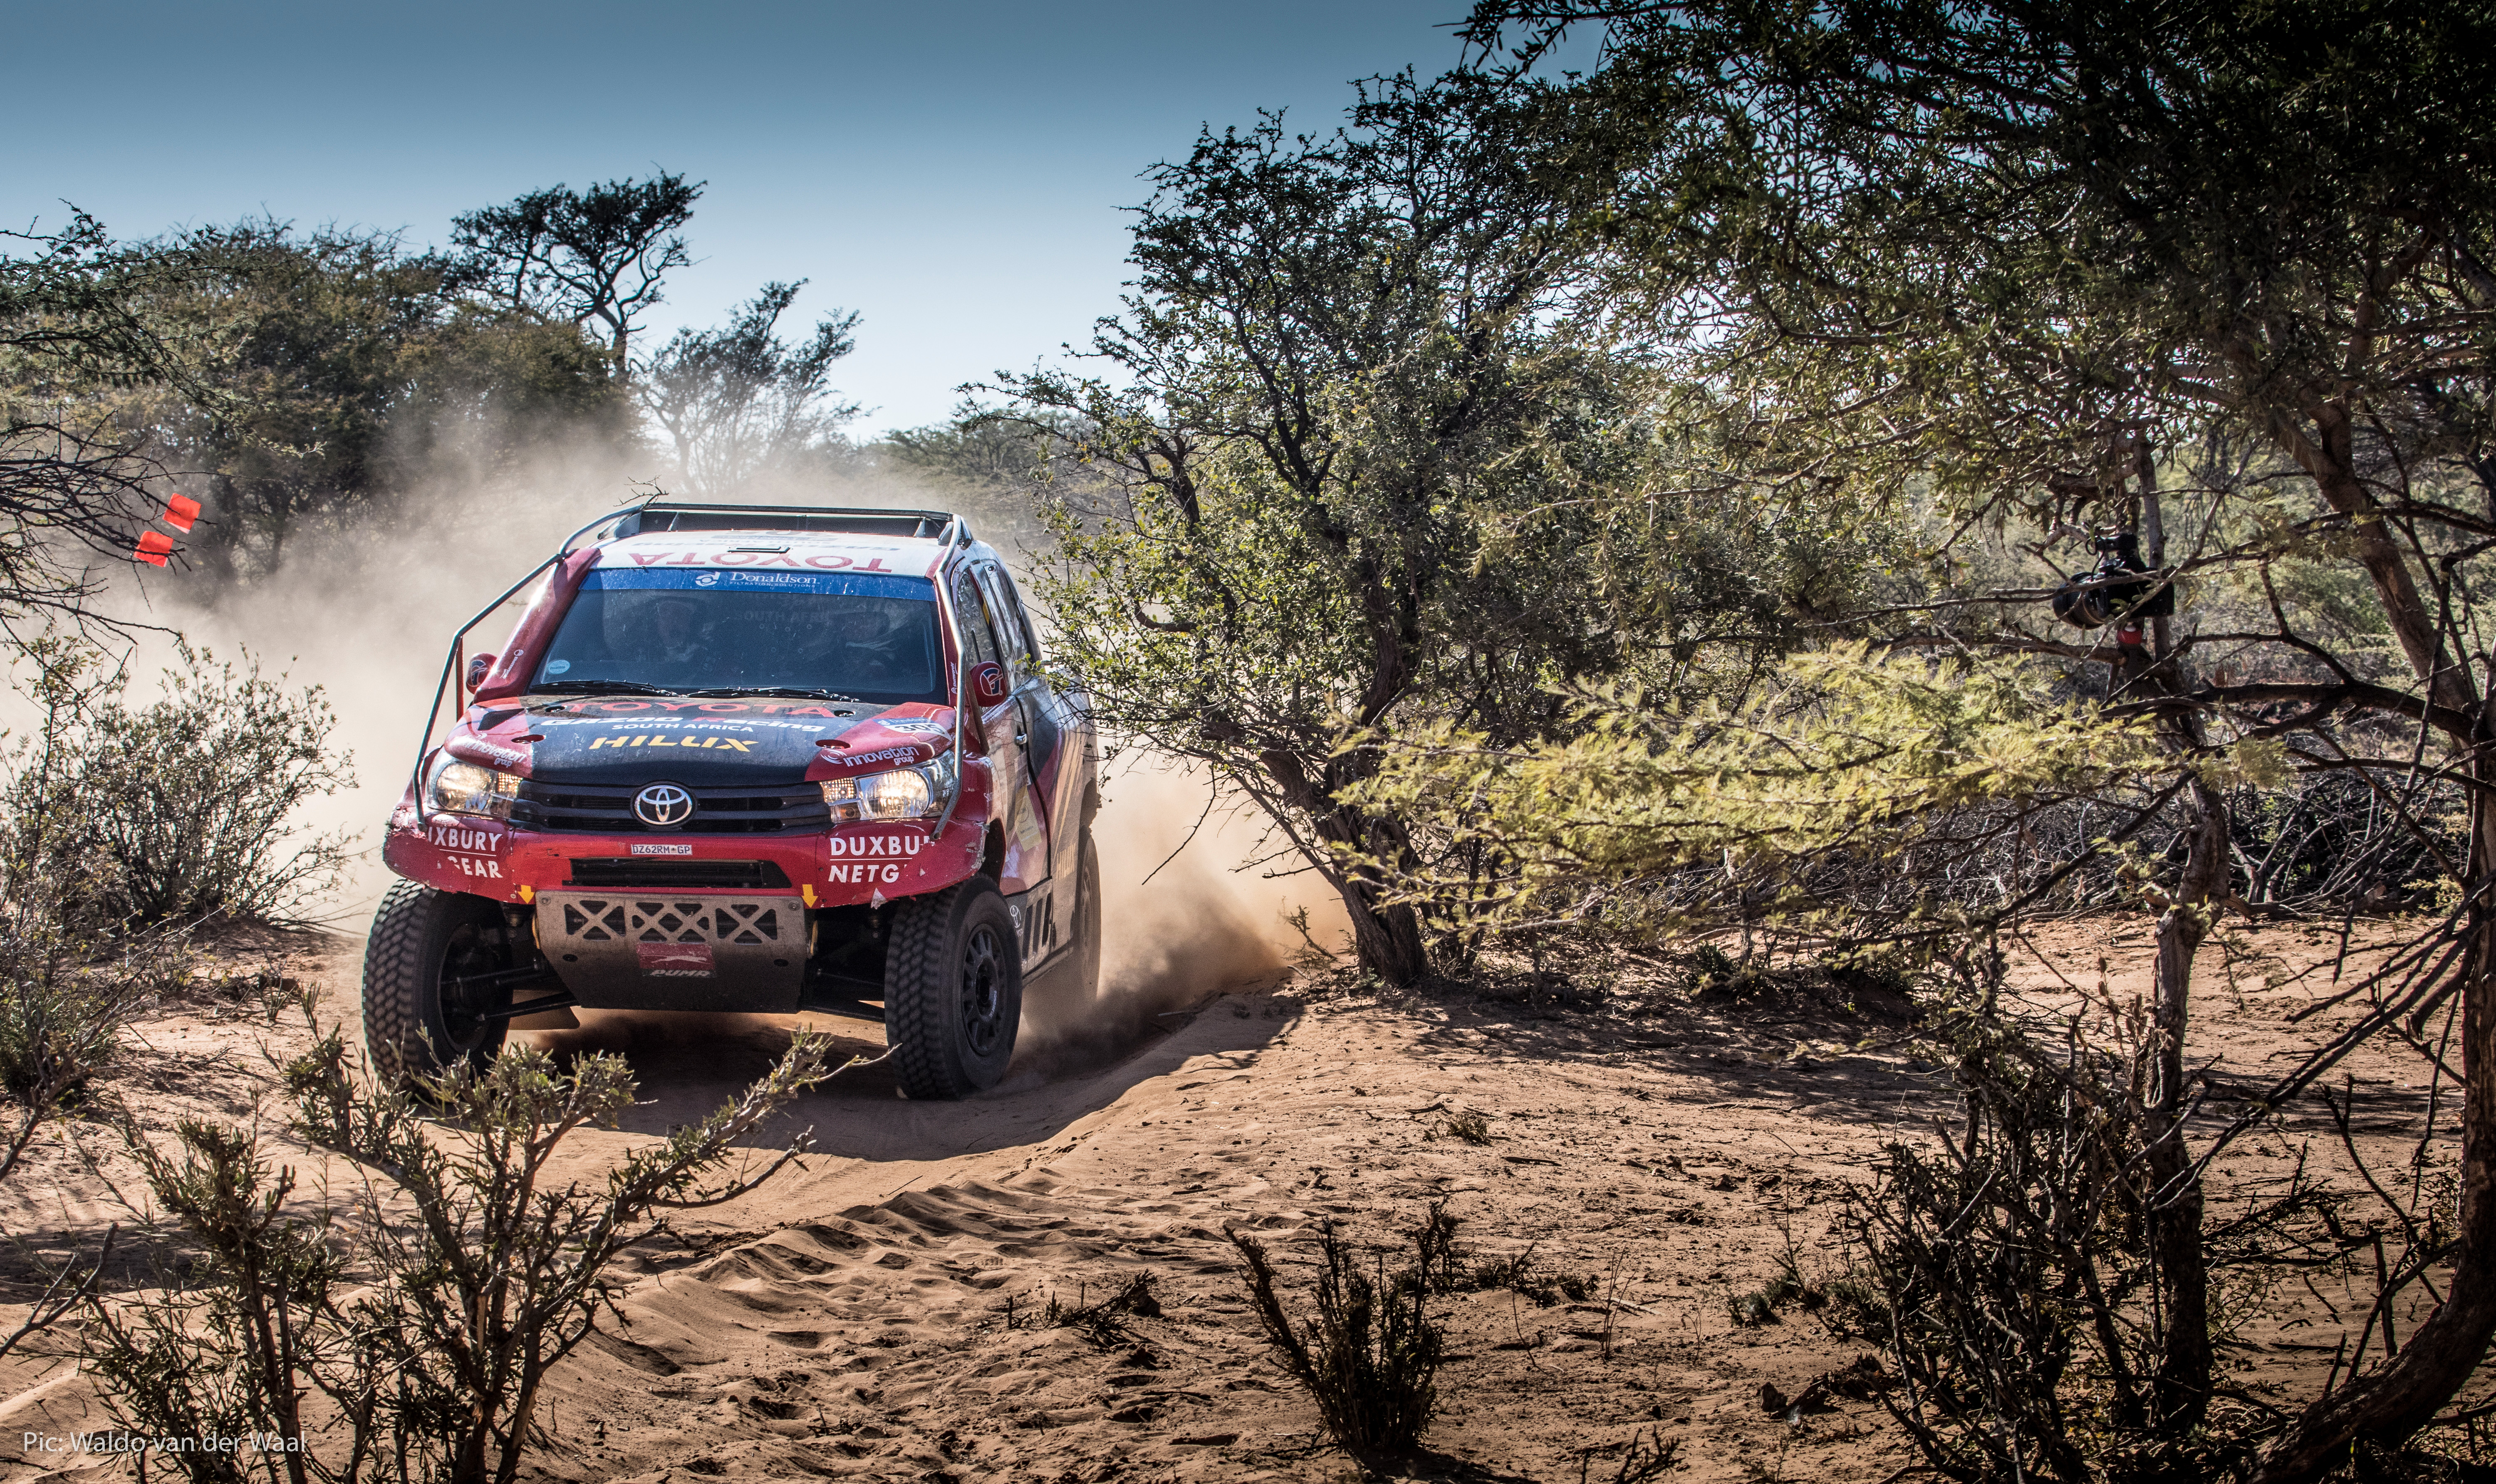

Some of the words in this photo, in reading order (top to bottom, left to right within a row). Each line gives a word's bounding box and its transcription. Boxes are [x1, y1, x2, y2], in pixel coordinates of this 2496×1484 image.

[628, 552, 892, 573] TOYOTA
[730, 571, 817, 584] Donaldson
[562, 702, 836, 718] TOYOTA
[541, 717, 683, 726] GAZOO
[691, 717, 826, 732] Racing
[683, 723, 754, 732] AFRICA
[894, 724, 946, 735] 305
[589, 735, 759, 752] HILUX
[494, 758, 513, 768] group
[894, 756, 914, 766] group
[632, 845, 670, 854] DZ62RM
[828, 863, 907, 883] NETG
